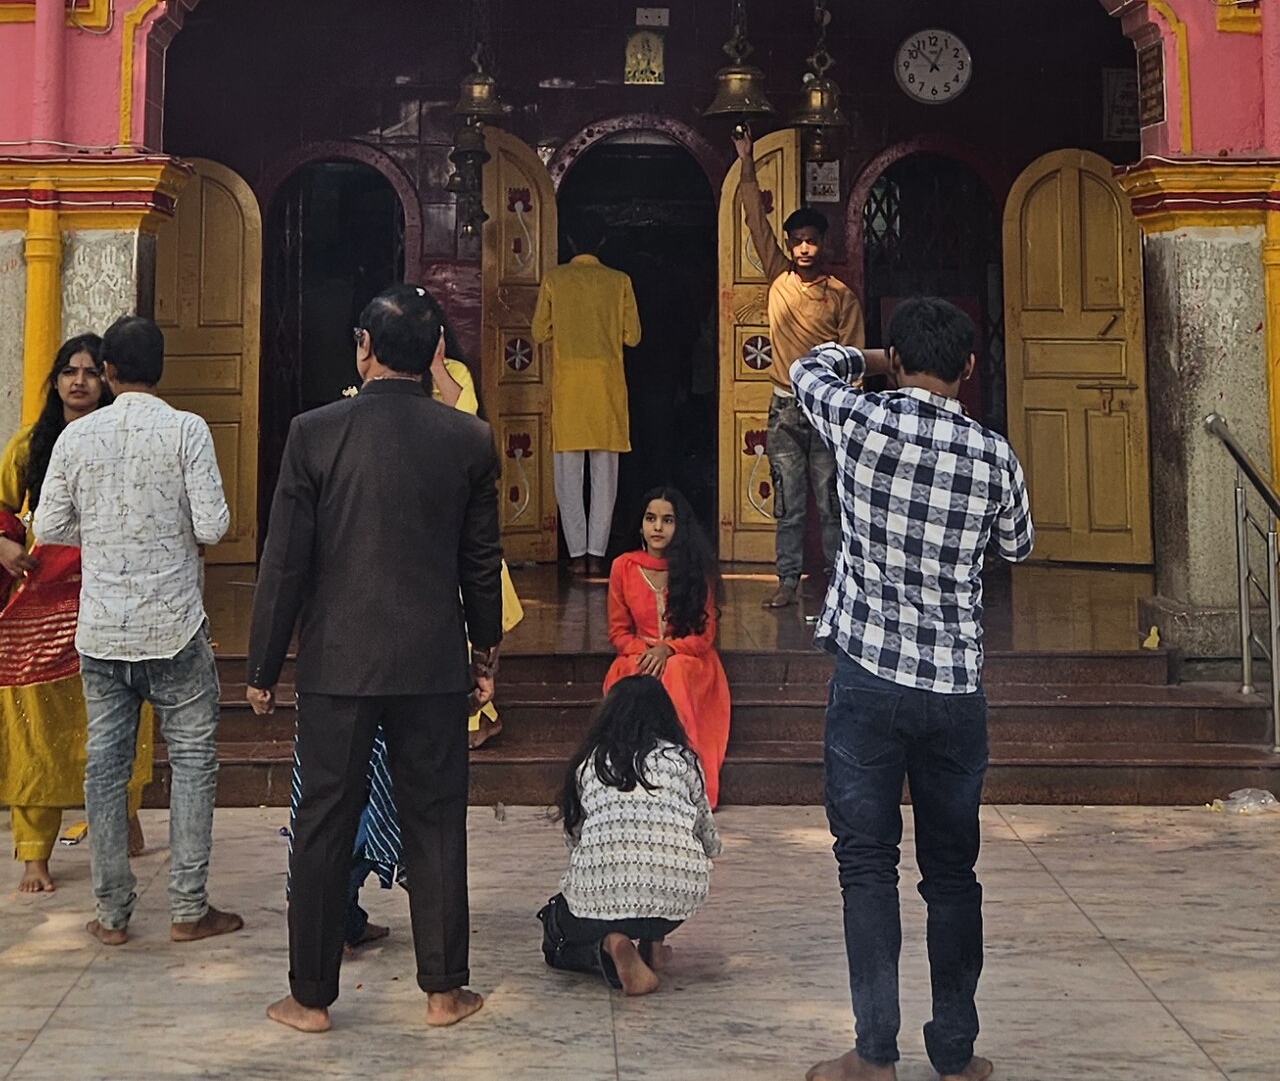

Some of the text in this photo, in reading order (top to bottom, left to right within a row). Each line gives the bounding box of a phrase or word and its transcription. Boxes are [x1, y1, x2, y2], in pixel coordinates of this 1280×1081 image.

[928, 35, 938, 47] 12
[944, 38, 949, 49] 1
[908, 49, 919, 60] 10
[953, 47, 960, 58] 2
[903, 61, 910, 71] 9
[957, 60, 964, 71] 3
[908, 73, 915, 84] 8
[952, 73, 960, 83] 4
[918, 82, 925, 92] 7
[931, 85, 938, 96] 6
[944, 82, 951, 93] 5
